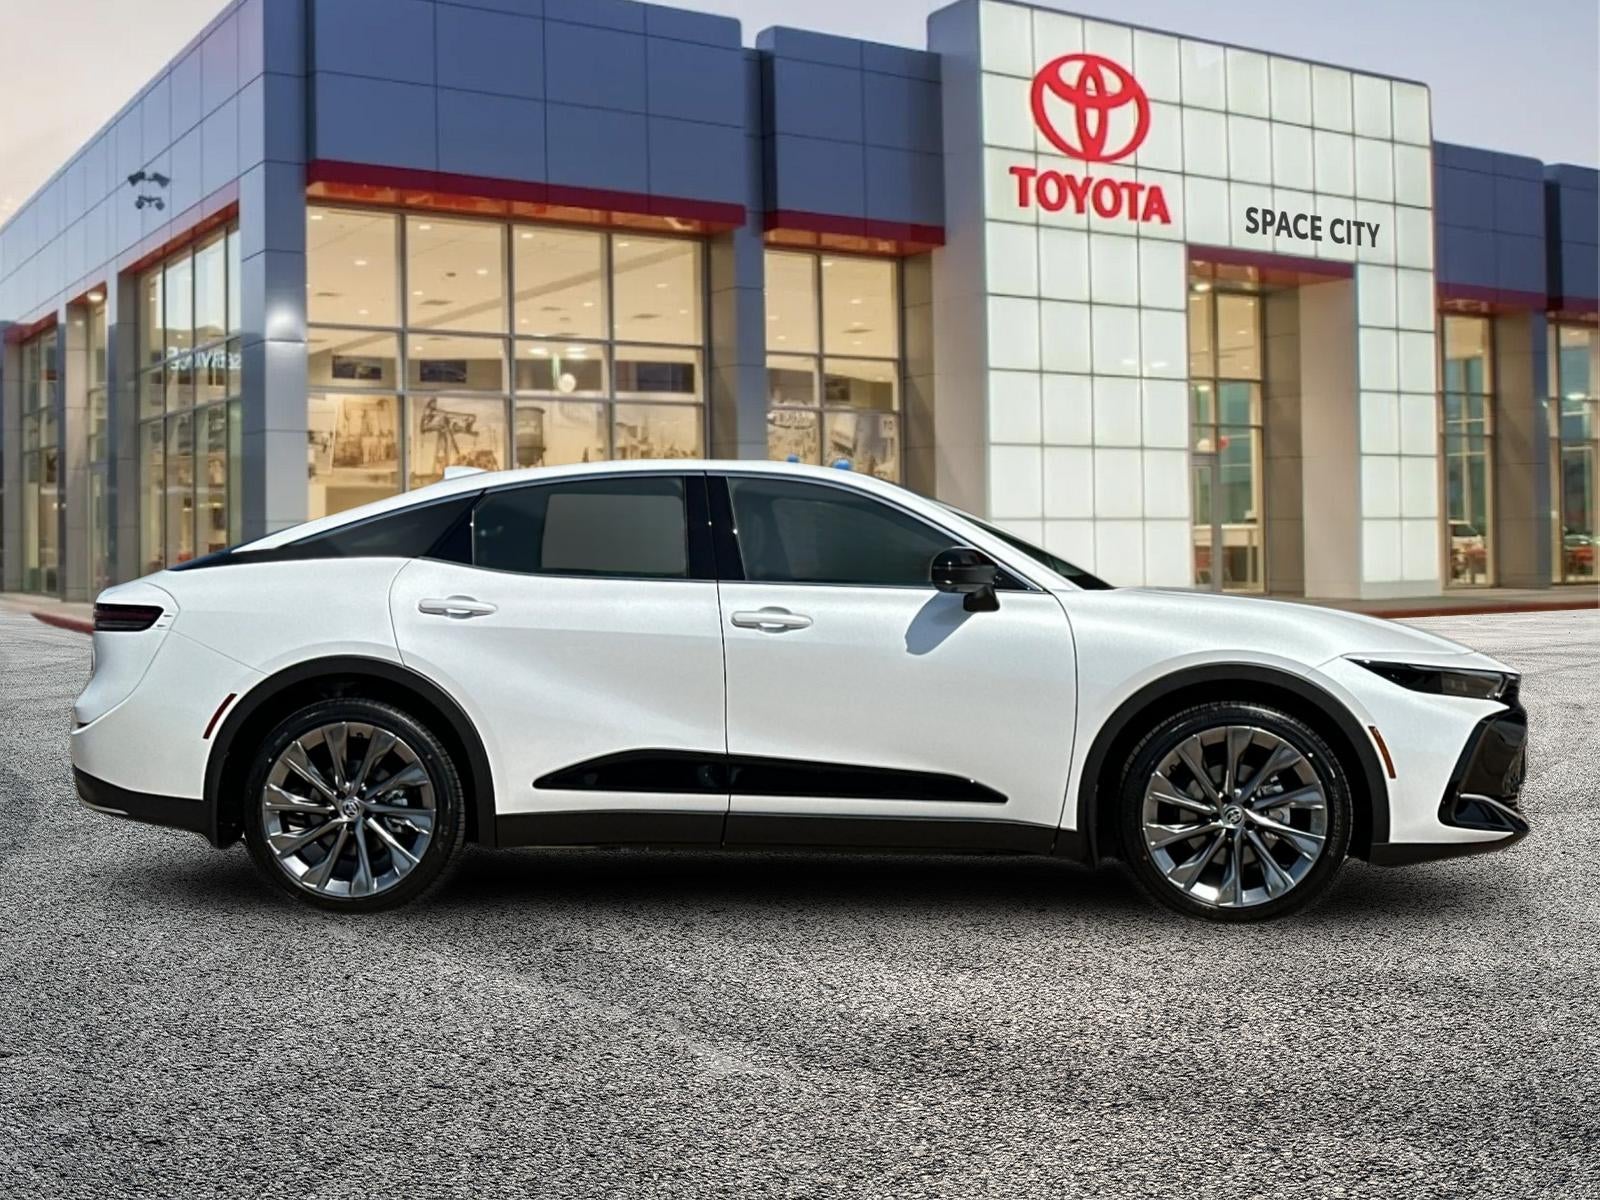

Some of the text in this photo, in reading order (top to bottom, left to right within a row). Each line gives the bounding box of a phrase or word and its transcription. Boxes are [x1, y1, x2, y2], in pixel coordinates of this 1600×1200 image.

[1009, 166, 1171, 224] TOYOTA
[1245, 207, 1380, 248] SPACE CITY
